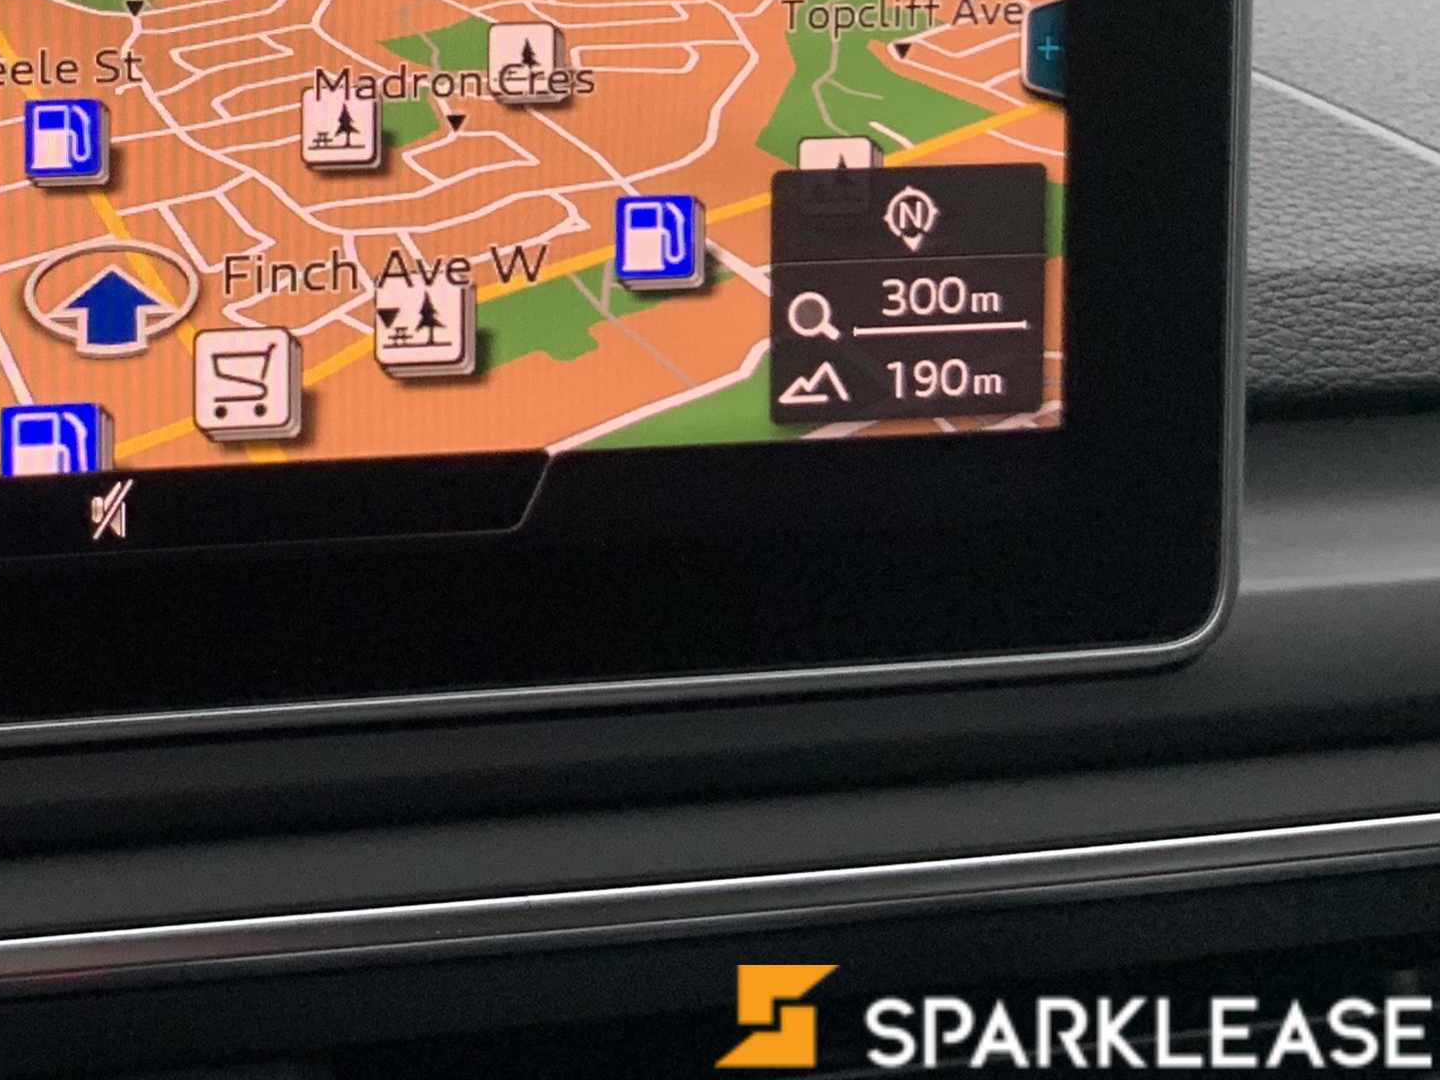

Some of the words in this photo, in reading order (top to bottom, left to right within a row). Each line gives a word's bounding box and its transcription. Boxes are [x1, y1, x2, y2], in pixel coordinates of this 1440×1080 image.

[96, 50, 144, 83] St
[314, 63, 482, 102] Madron
[497, 62, 596, 97] Cres
[898, 200, 923, 230] N
[223, 249, 359, 295] Finch
[378, 247, 472, 287] Ave
[491, 244, 548, 283] W
[881, 276, 1001, 317] 300m
[886, 357, 1004, 399] 190m
